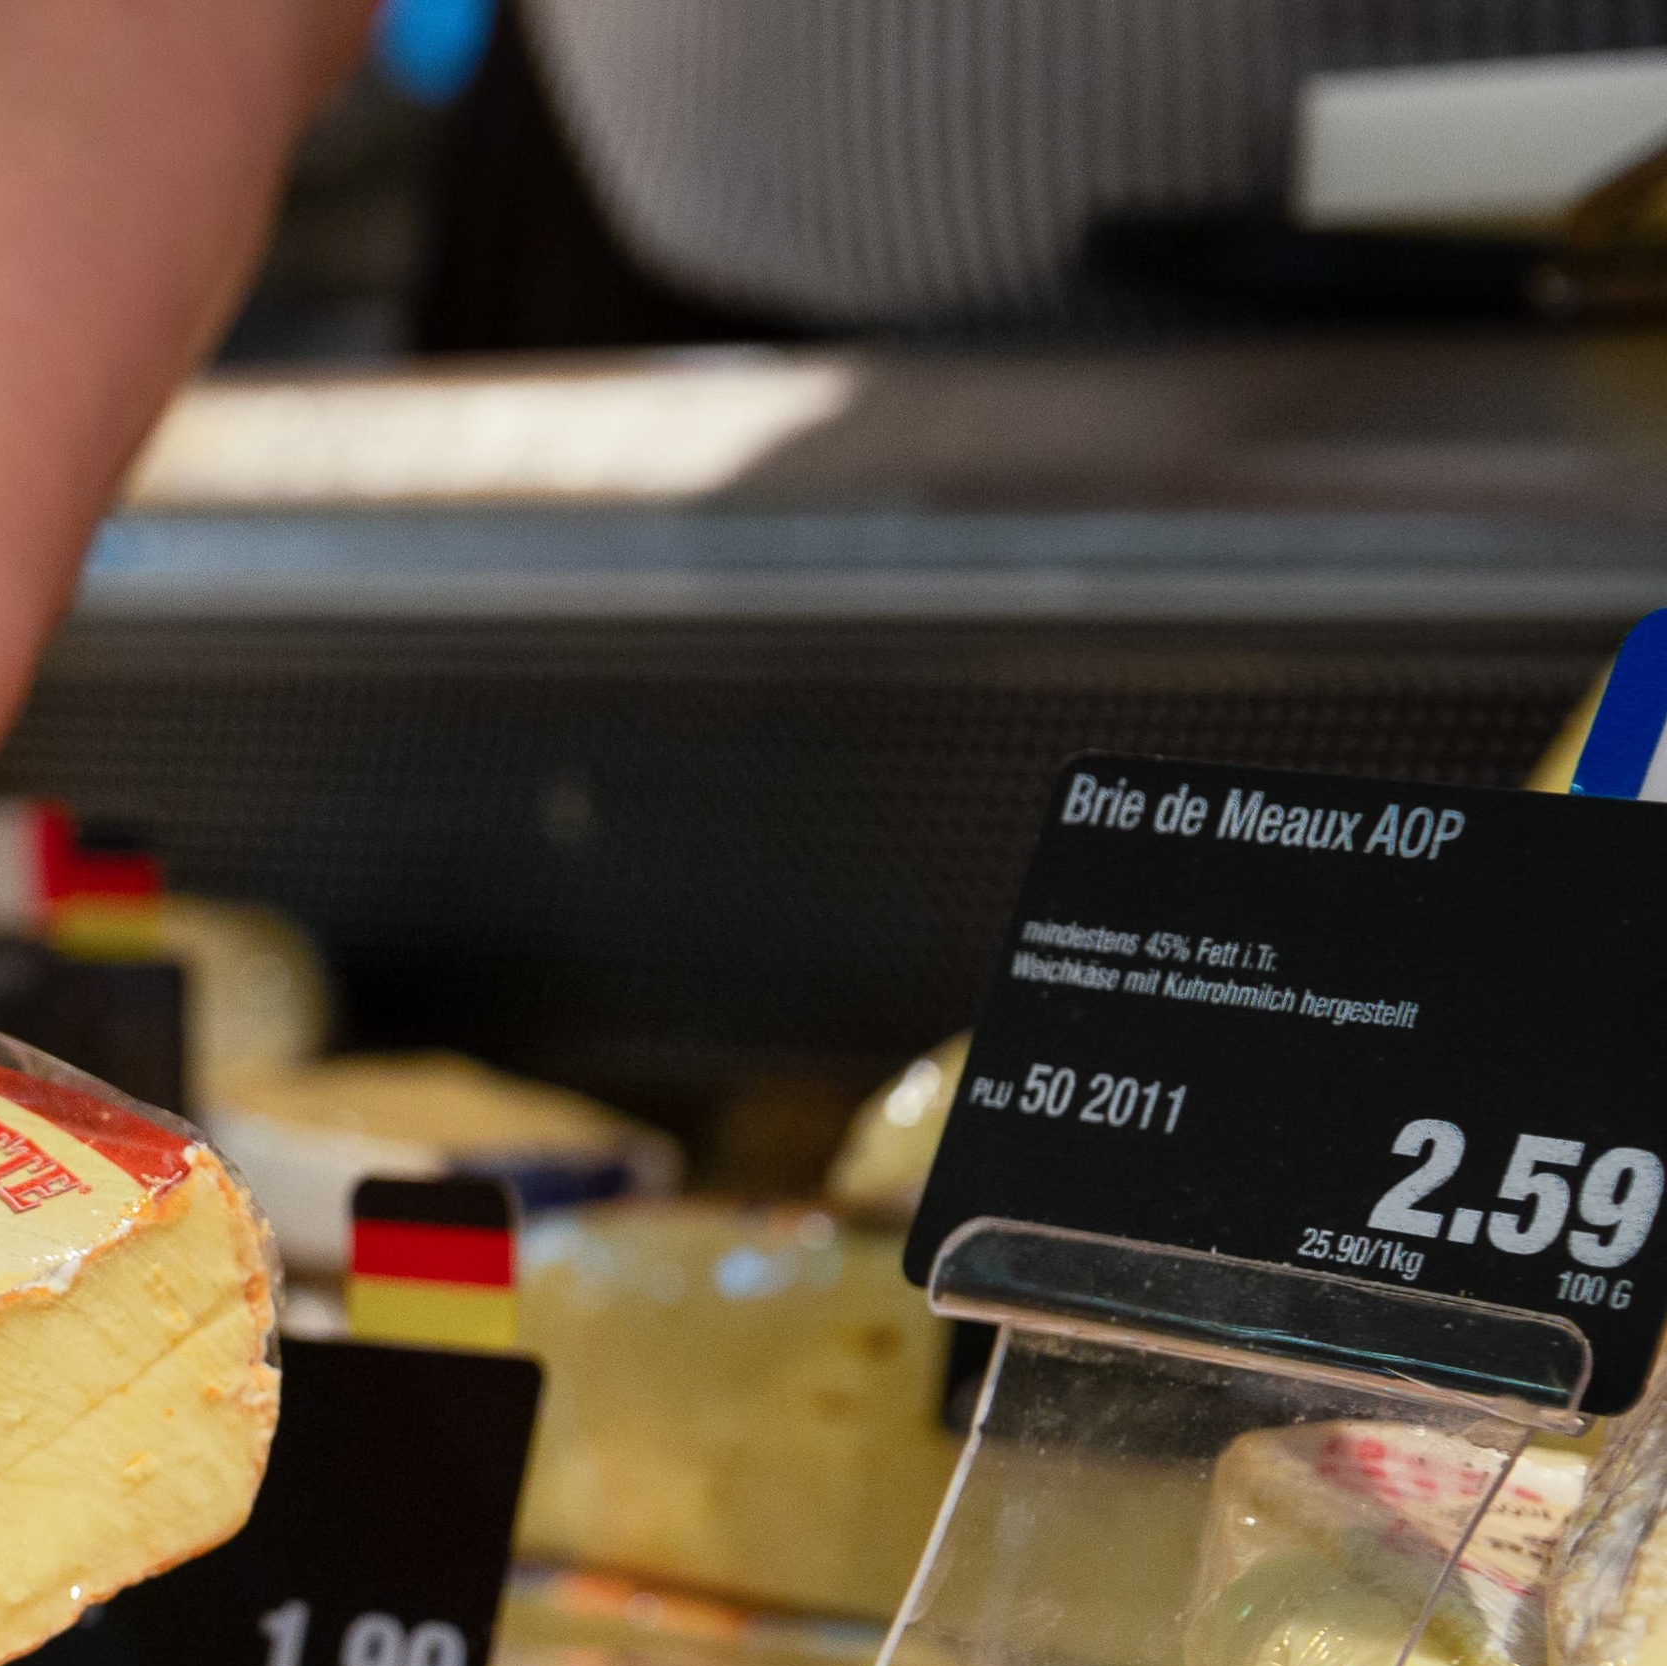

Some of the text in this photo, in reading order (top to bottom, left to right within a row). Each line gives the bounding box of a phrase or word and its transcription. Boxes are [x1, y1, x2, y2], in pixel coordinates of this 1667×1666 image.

[1061, 773, 1466, 860] Brie de Meaux AOP
[1021, 919, 1140, 957] mindestens
[1144, 932, 1192, 963] 45%
[1196, 937, 1240, 969] Fett
[1010, 951, 1420, 1029] Weichkäse mit Kuhrohmilch hergestellt
[969, 1063, 1187, 1134] PLU 50 2011
[1367, 1118, 1667, 1269] 2.59
[1298, 1226, 1425, 1281] 25.90/1kg
[1557, 1269, 1634, 1320] 100 G
